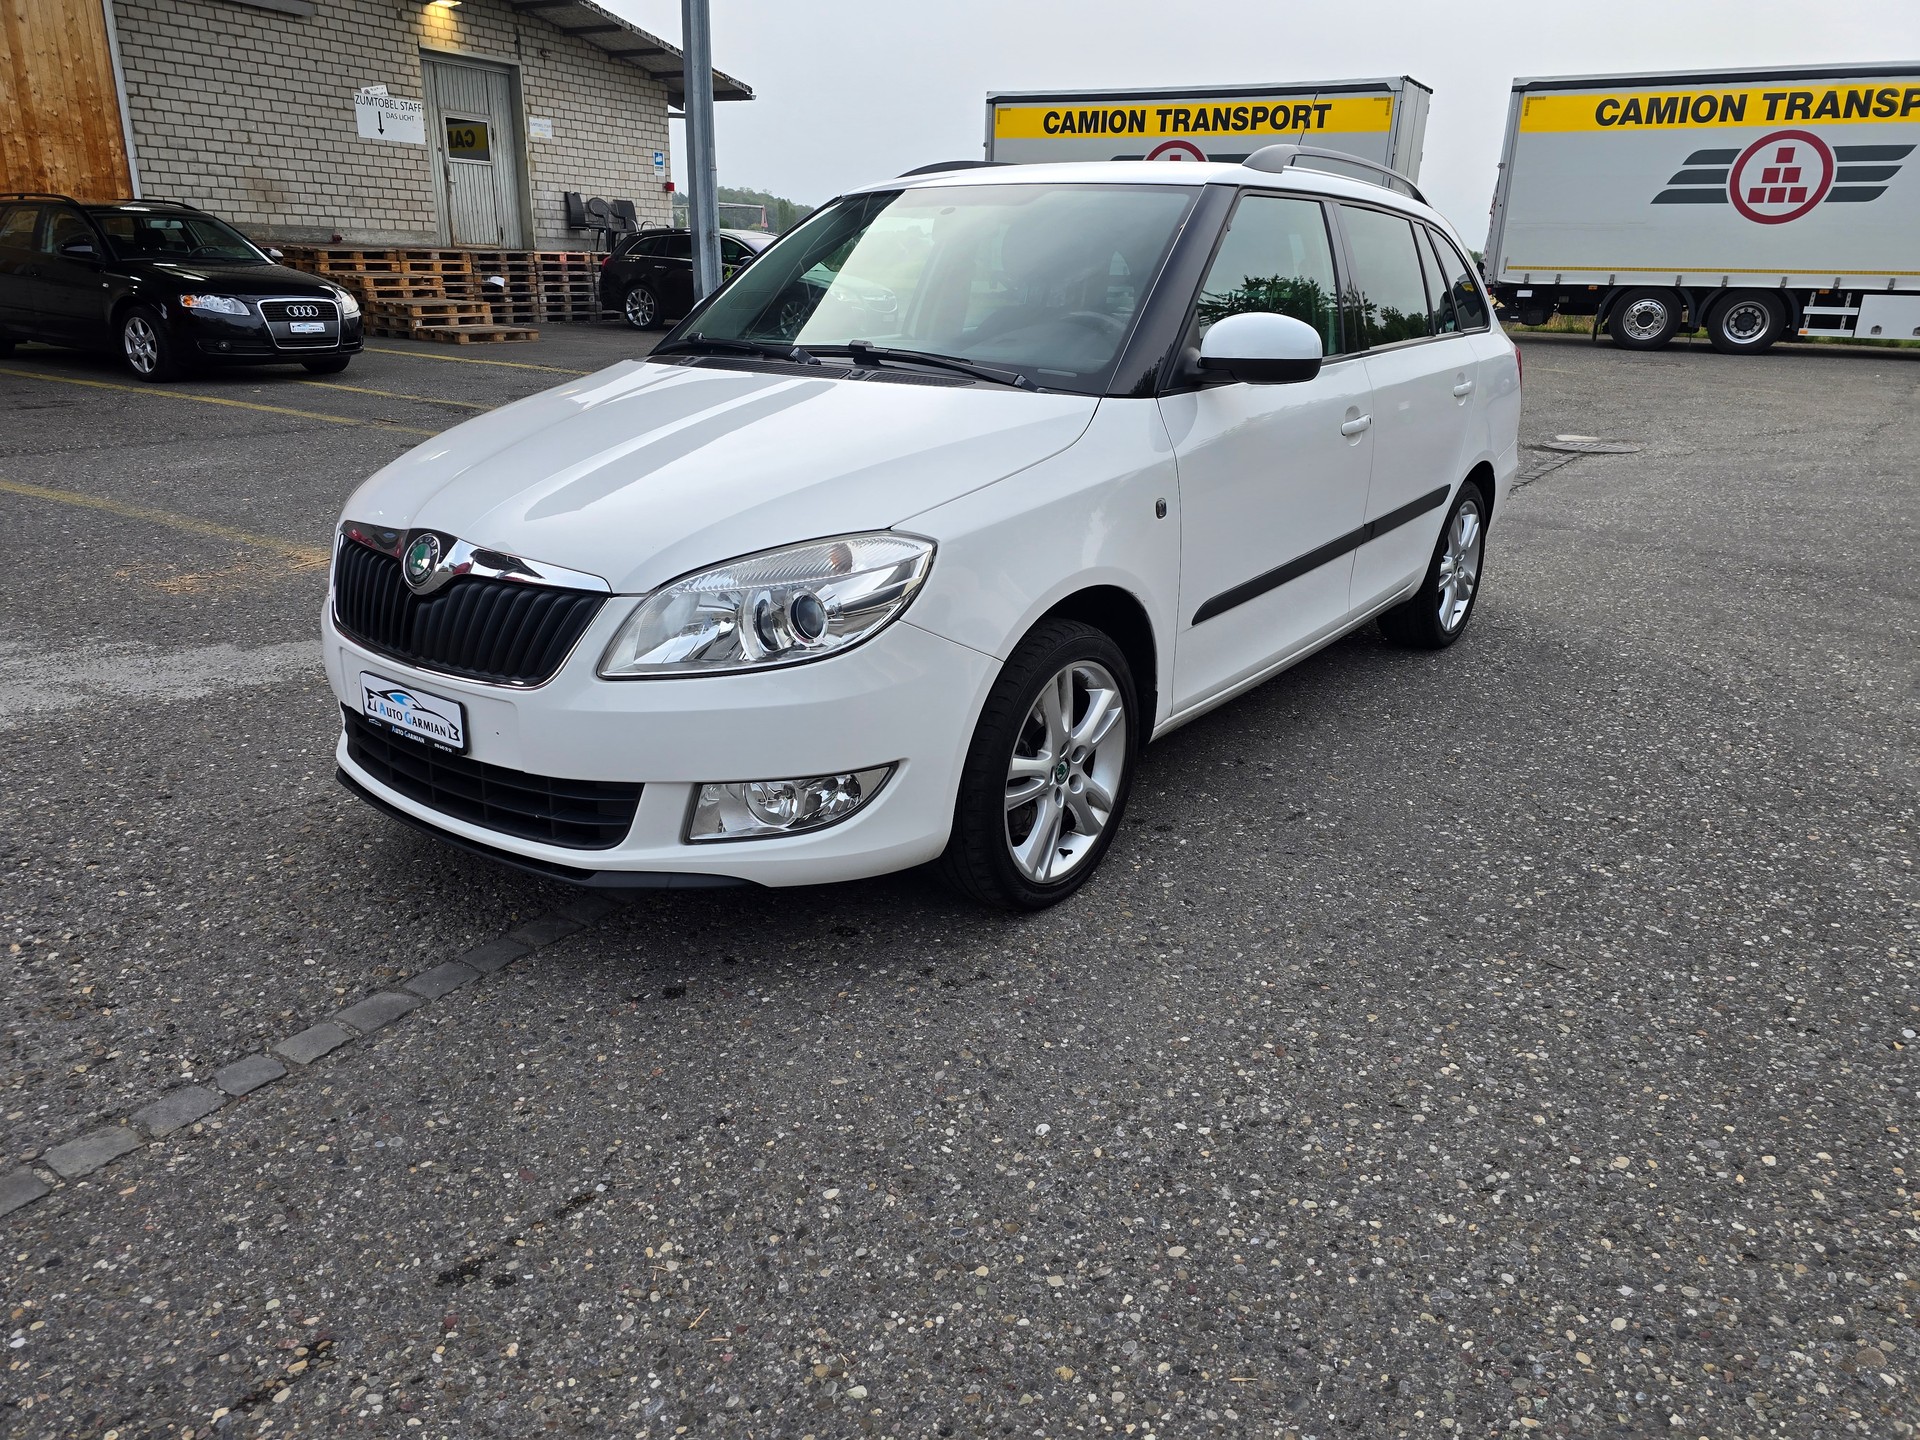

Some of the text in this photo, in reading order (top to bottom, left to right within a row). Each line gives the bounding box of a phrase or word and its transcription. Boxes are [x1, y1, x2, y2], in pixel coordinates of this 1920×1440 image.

[355, 95, 422, 112] ZUMTOBEL STAFF
[386, 112, 415, 122] DAS LICHT
[1595, 86, 1920, 126] CAMION TRANSP
[1043, 104, 1332, 134] CAMION TRANSPORT
[379, 702, 446, 737] AUTO GARMIAN
